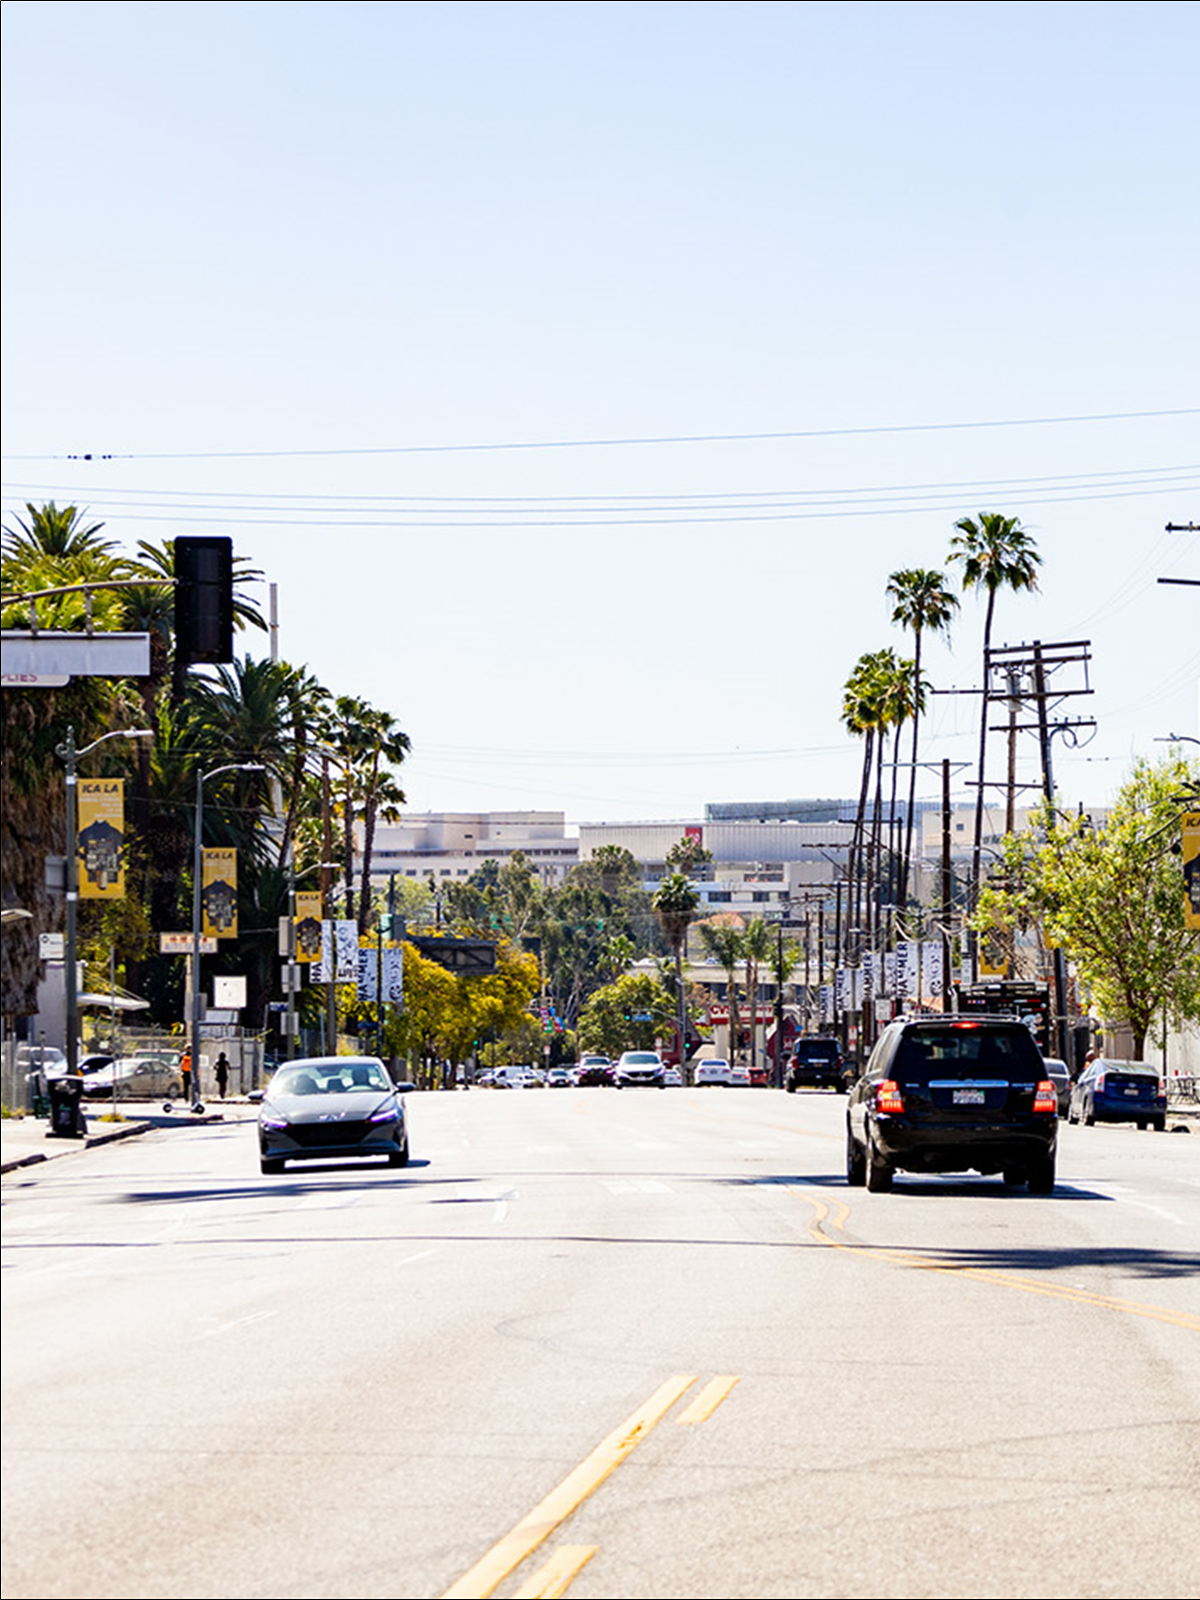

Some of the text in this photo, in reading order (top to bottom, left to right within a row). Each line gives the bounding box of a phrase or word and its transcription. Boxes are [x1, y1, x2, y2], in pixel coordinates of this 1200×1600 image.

[82, 784, 119, 793] ICA LA
[358, 949, 369, 1001] HAMMER
[897, 943, 908, 998] HAMMER
